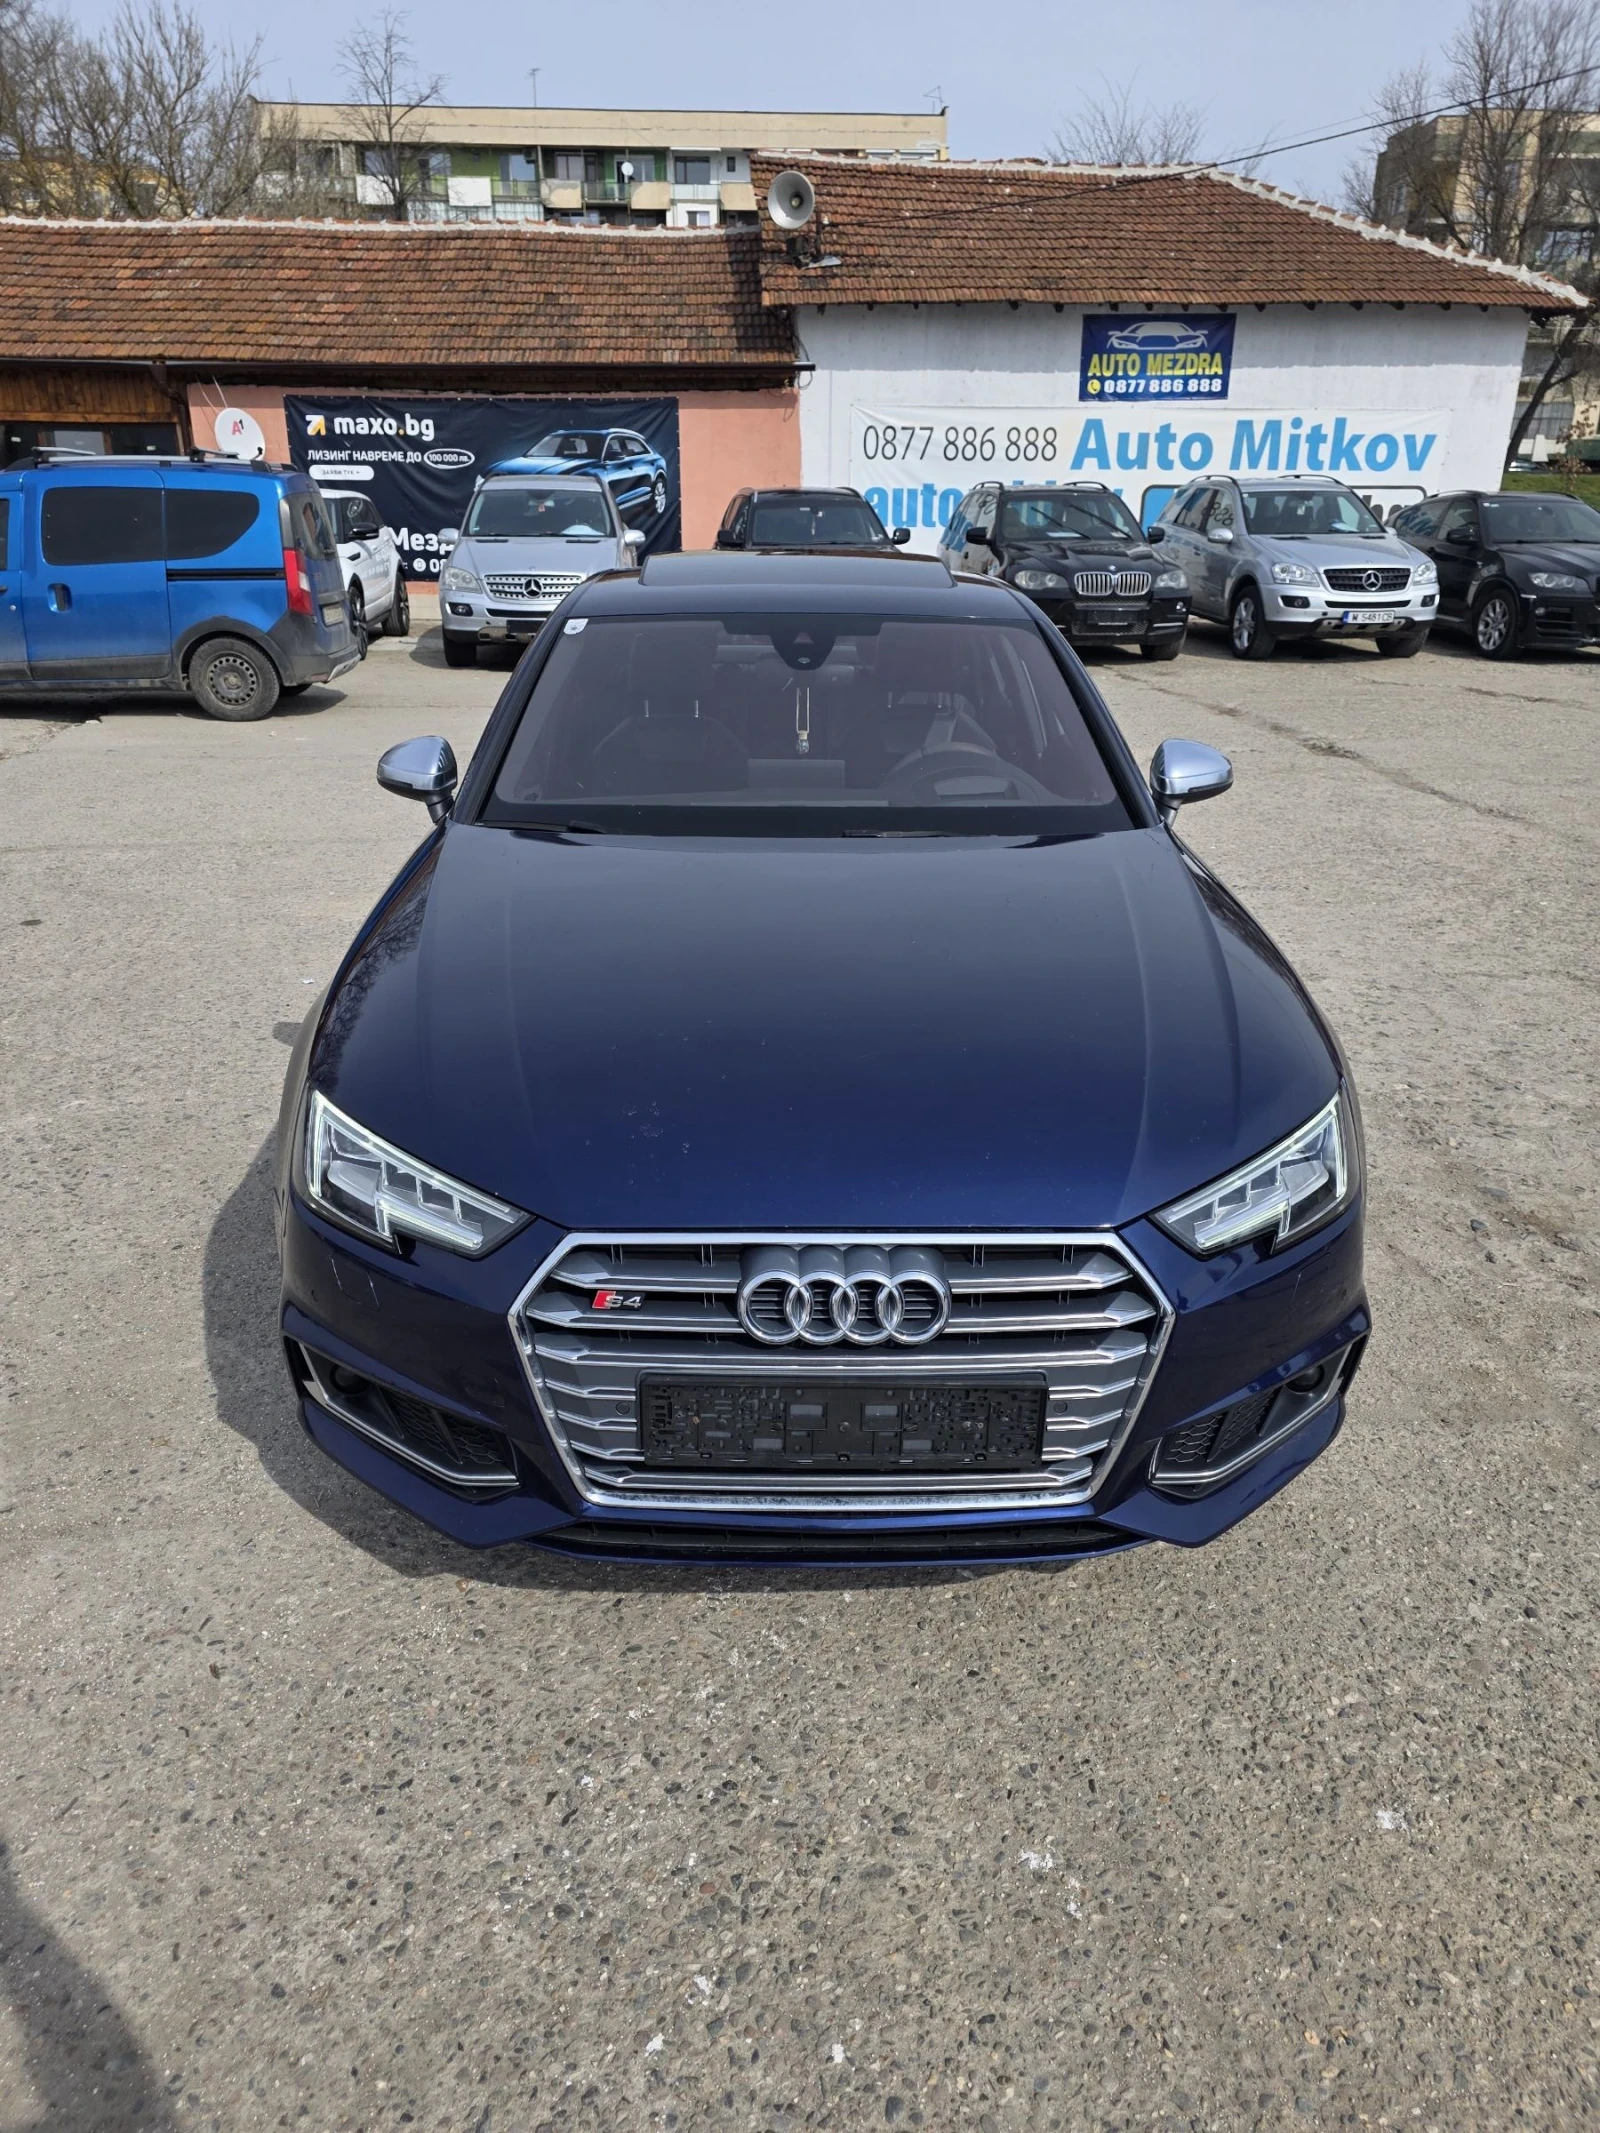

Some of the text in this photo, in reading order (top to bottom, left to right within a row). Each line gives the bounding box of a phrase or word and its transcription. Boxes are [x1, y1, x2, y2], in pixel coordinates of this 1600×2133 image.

[1087, 352, 1223, 377] AUTO MEZDRA
[1104, 378, 1223, 394] 0877 886 888
[231, 418, 244, 436] A1
[333, 412, 435, 442] maxo.bg
[863, 416, 1438, 472] 0877 886 888 Auto Mitkov
[307, 450, 351, 462] ЛИЗИНГ
[352, 451, 404, 463] НАВРЕМЕ
[405, 451, 422, 464] ДО
[428, 453, 442, 462] 100
[442, 453, 459, 462] 000
[603, 1295, 642, 1309] S4
